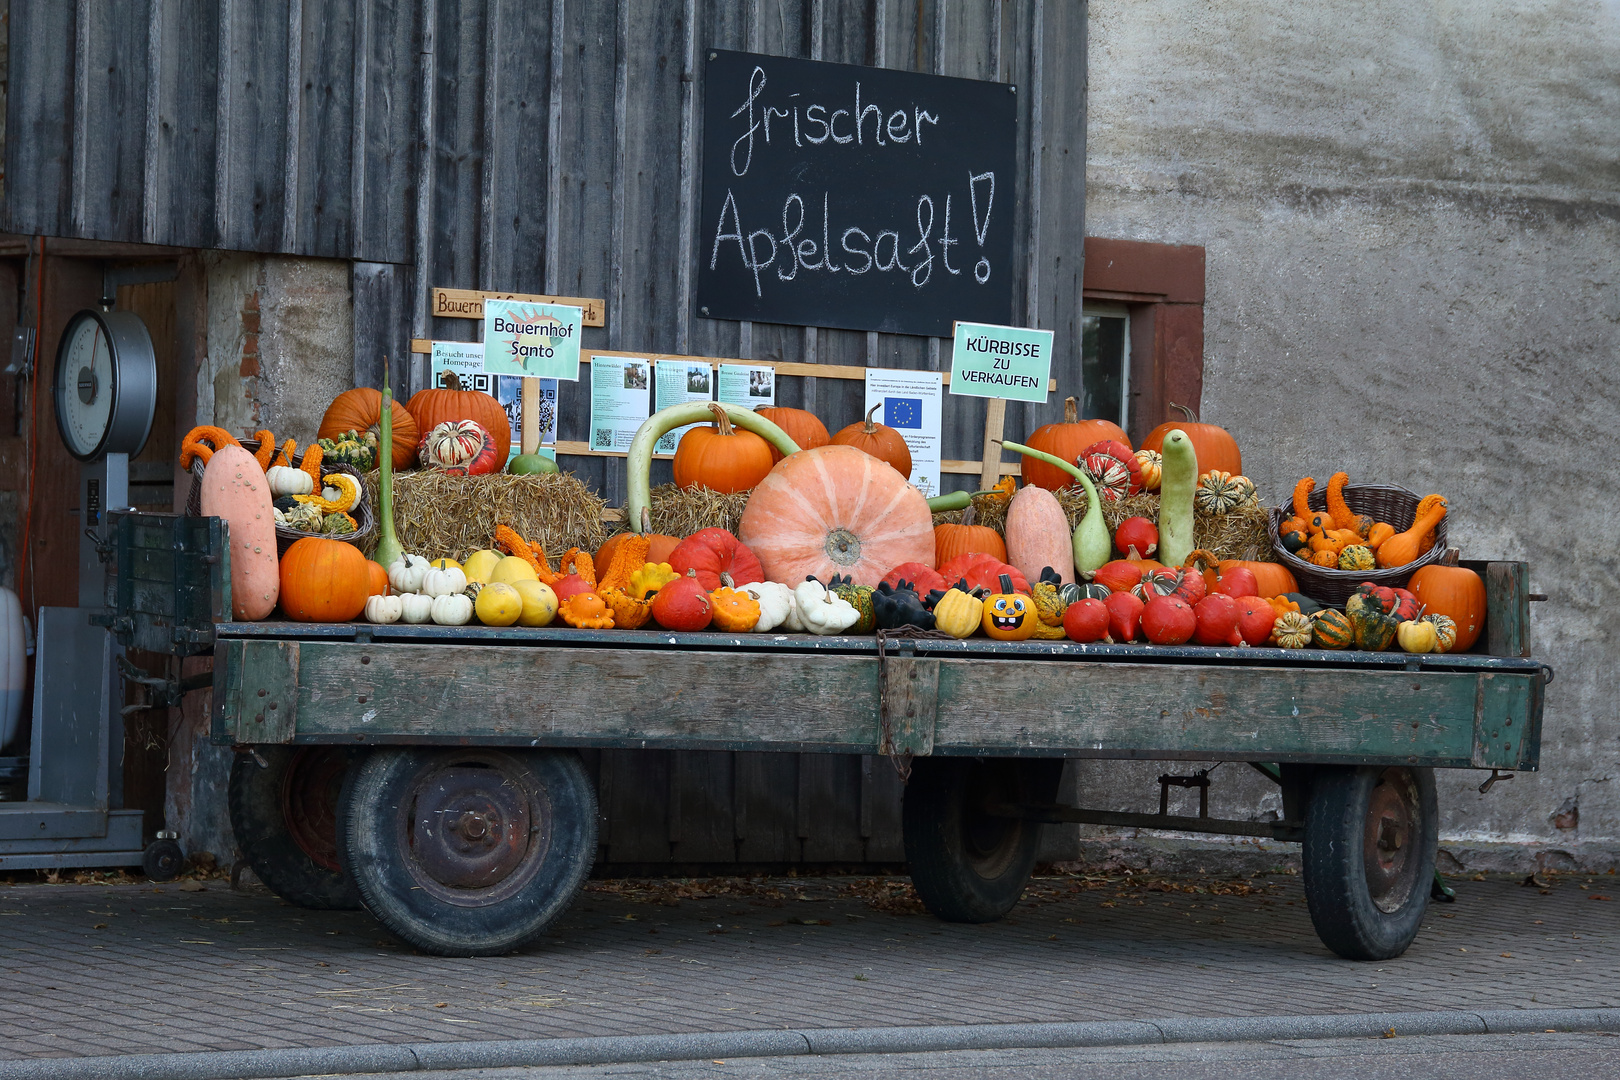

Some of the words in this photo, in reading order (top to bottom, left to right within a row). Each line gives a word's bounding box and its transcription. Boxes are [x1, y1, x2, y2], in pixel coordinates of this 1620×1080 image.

[729, 65, 939, 177] frischer
[709, 170, 996, 297] Apfelsaft!
[494, 317, 573, 338] Bauernhof
[436, 349, 464, 358] Besucht
[511, 340, 554, 358] Santo
[966, 336, 1041, 358] KÜRBISSE
[993, 358, 1010, 370] ZU
[962, 370, 1039, 388] VERKAUFEN
